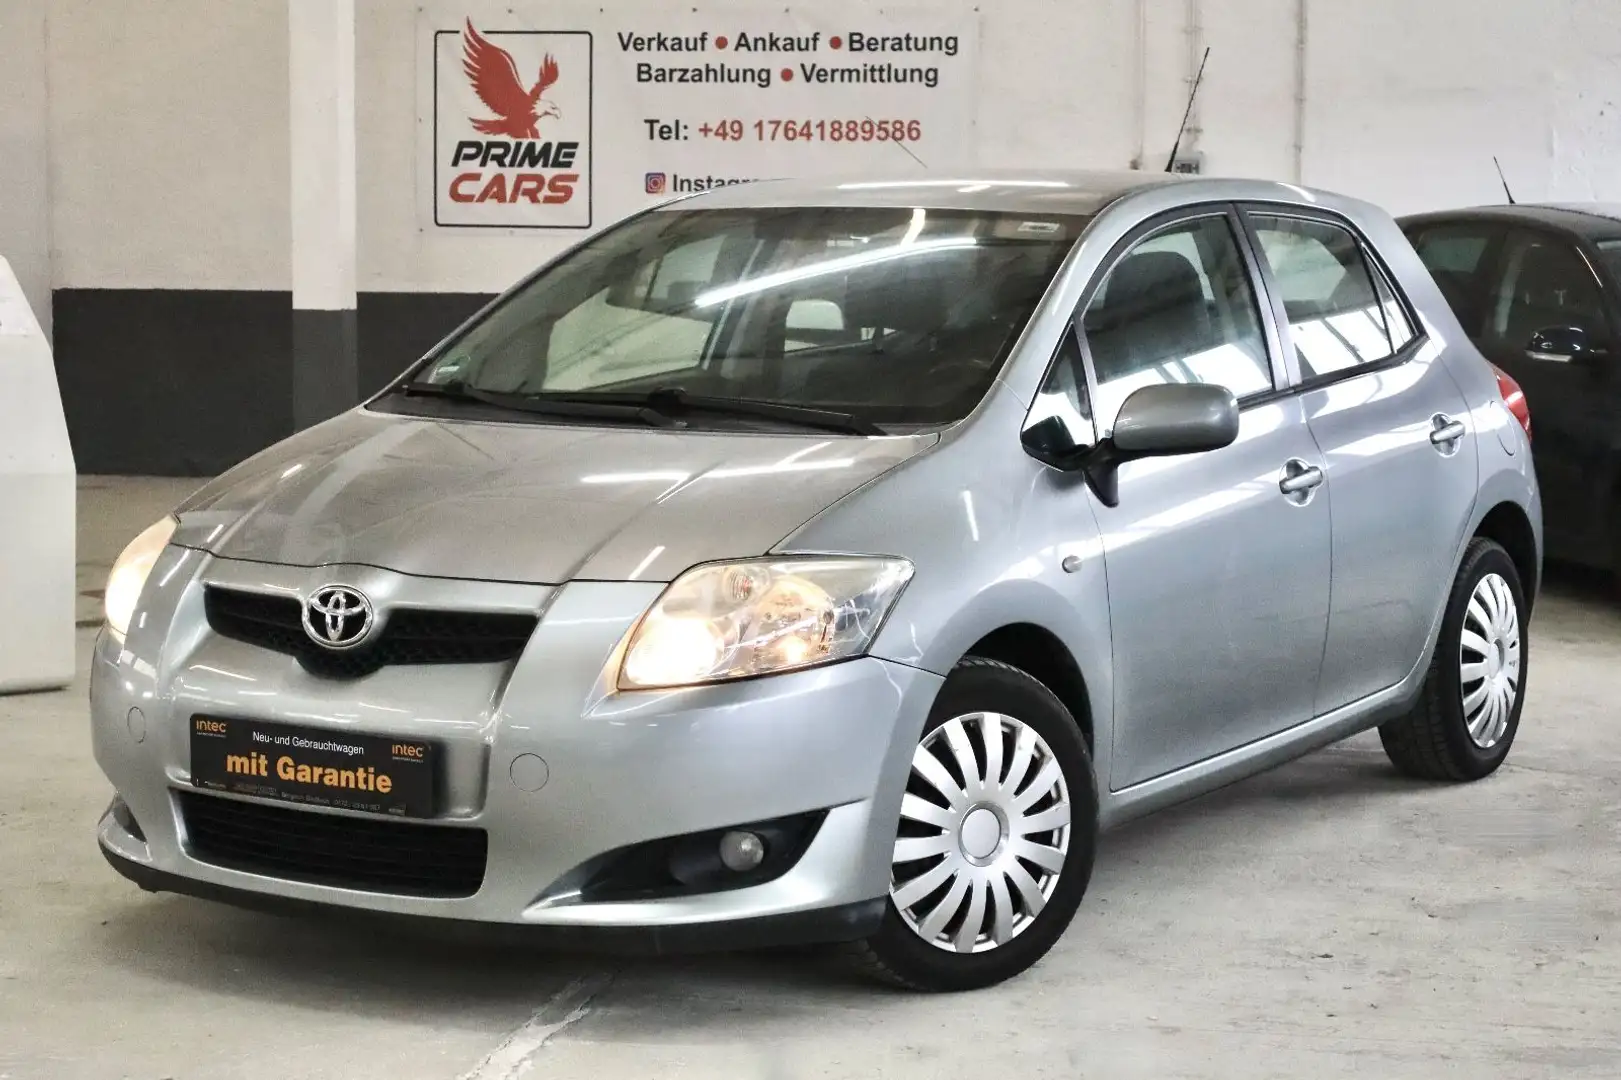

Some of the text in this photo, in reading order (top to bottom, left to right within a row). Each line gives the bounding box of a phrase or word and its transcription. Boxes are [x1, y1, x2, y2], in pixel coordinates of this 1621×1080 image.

[617, 32, 958, 57] Verkauf Ankauf Beratung
[636, 62, 939, 88] Barzahlung Vermittlung
[644, 119, 921, 142] Tel: +49 17641889586
[451, 140, 580, 169] PRIME
[448, 172, 580, 205] CARS
[252, 731, 364, 755] Neu- und Gebrauchtwagen
[226, 751, 268, 777] mit
[276, 756, 393, 793] Garantie
